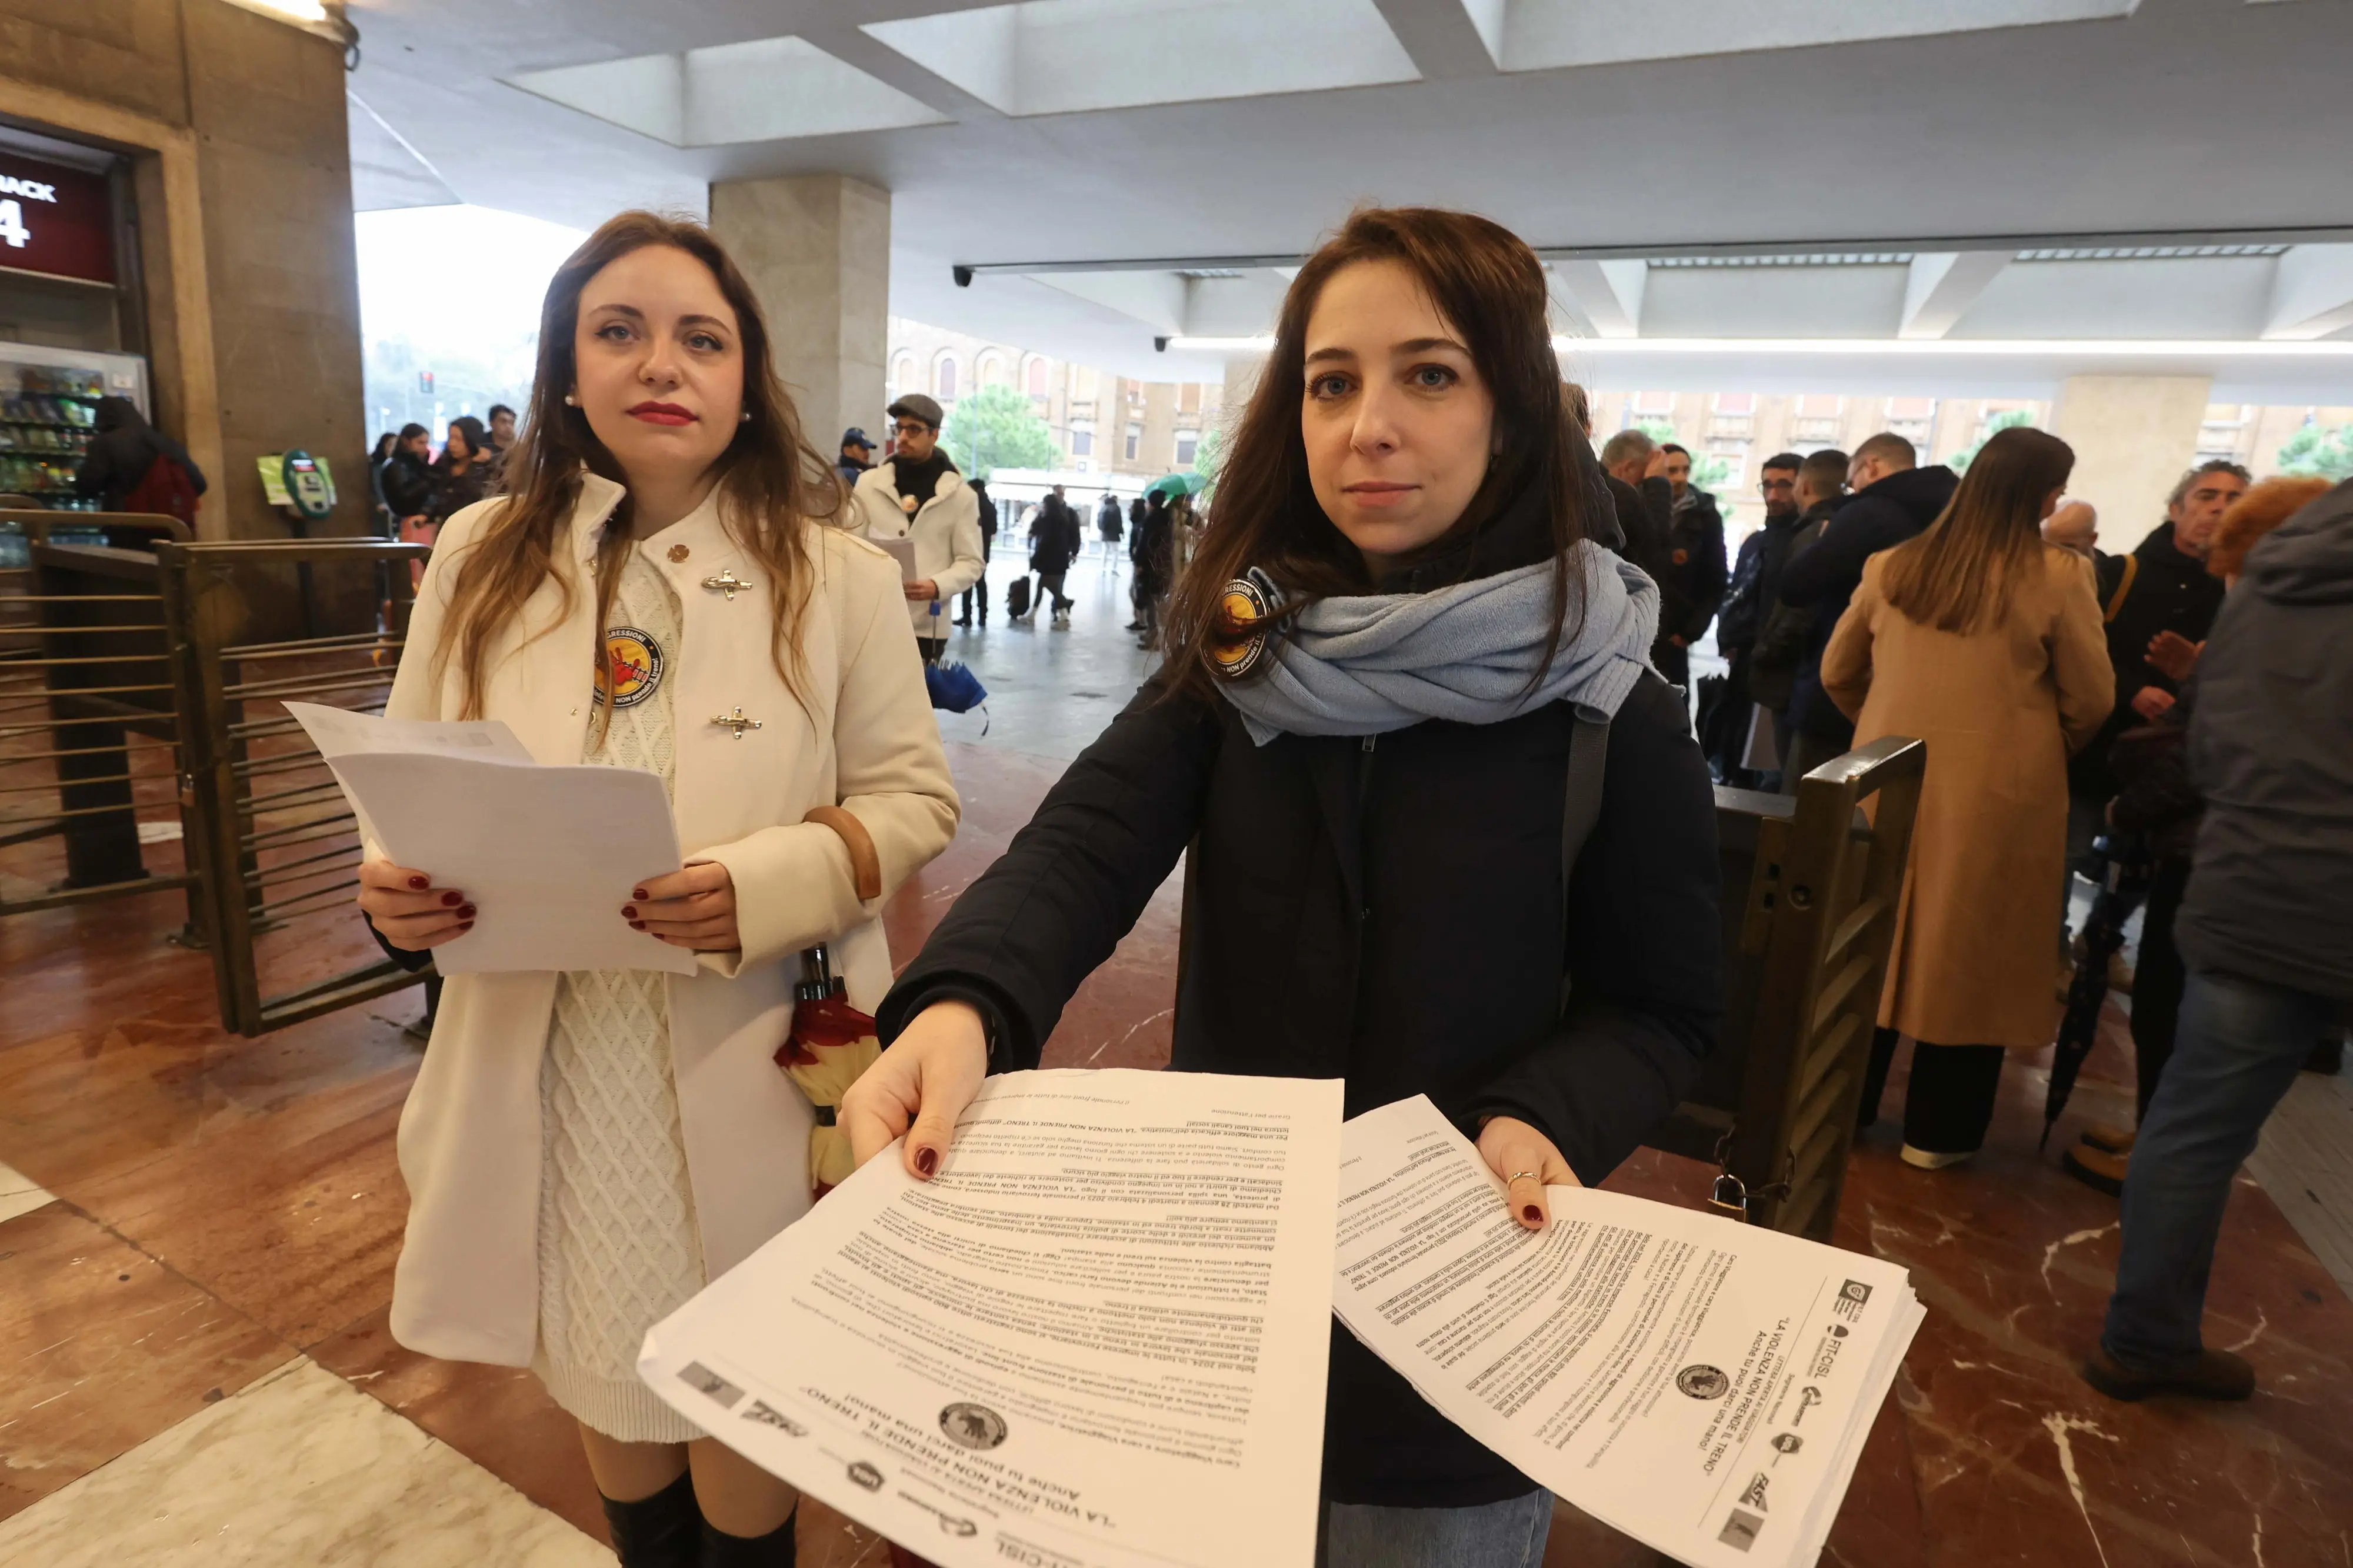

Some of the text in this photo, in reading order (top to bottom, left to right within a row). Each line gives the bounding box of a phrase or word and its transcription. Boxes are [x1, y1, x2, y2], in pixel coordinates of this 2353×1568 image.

[0, 199, 31, 248] 4
[1222, 583, 1254, 597] RESSIONI
[1240, 648, 1258, 669] prende
[632, 682, 652, 700] prende
[1039, 1121, 1067, 1129] PRENDE
[1222, 1129, 1258, 1139] maggiore
[1037, 1175, 1073, 1184] sostenere
[1086, 1169, 1099, 1177] più
[1099, 1170, 1126, 1179] viaggio
[1192, 1175, 1224, 1183] rendere
[1021, 1183, 1059, 1192] VIOLENZA
[1127, 1179, 1160, 1188] impegno
[1246, 1179, 1282, 1187] Sindacati
[1001, 1191, 1040, 1199] ferroviario
[1041, 1192, 1079, 1201] personale
[1080, 1186, 1098, 1195] logo
[1128, 1187, 1184, 1197] personalizzata
[1187, 1190, 1208, 1198] spilla
[1232, 1192, 1269, 1202] protesta,
[1239, 1186, 1281, 1195] Chiediamo
[1187, 1198, 1219, 1207] gennaio
[1755, 1330, 1784, 1377] VIOLENZA
[1814, 1339, 1841, 1379] FIT-CISL
[1697, 1330, 1768, 1452] Anche tu puoi darci una mano!
[1745, 1375, 1764, 1397] NON
[842, 1394, 891, 1424] mano!
[1725, 1395, 1753, 1433] PRENDE
[867, 1419, 879, 1434] IL
[892, 1420, 925, 1439] una
[1719, 1430, 1733, 1442] IL
[881, 1429, 948, 1470] PRENDE
[924, 1433, 966, 1461] darci
[968, 1451, 1004, 1476] puoi
[951, 1462, 990, 1487] NON
[1006, 1468, 1024, 1484] tu
[1026, 1476, 1081, 1502] Anche
[1750, 1473, 1769, 1507] FAST
[994, 1480, 1081, 1519] VIOLENZA
